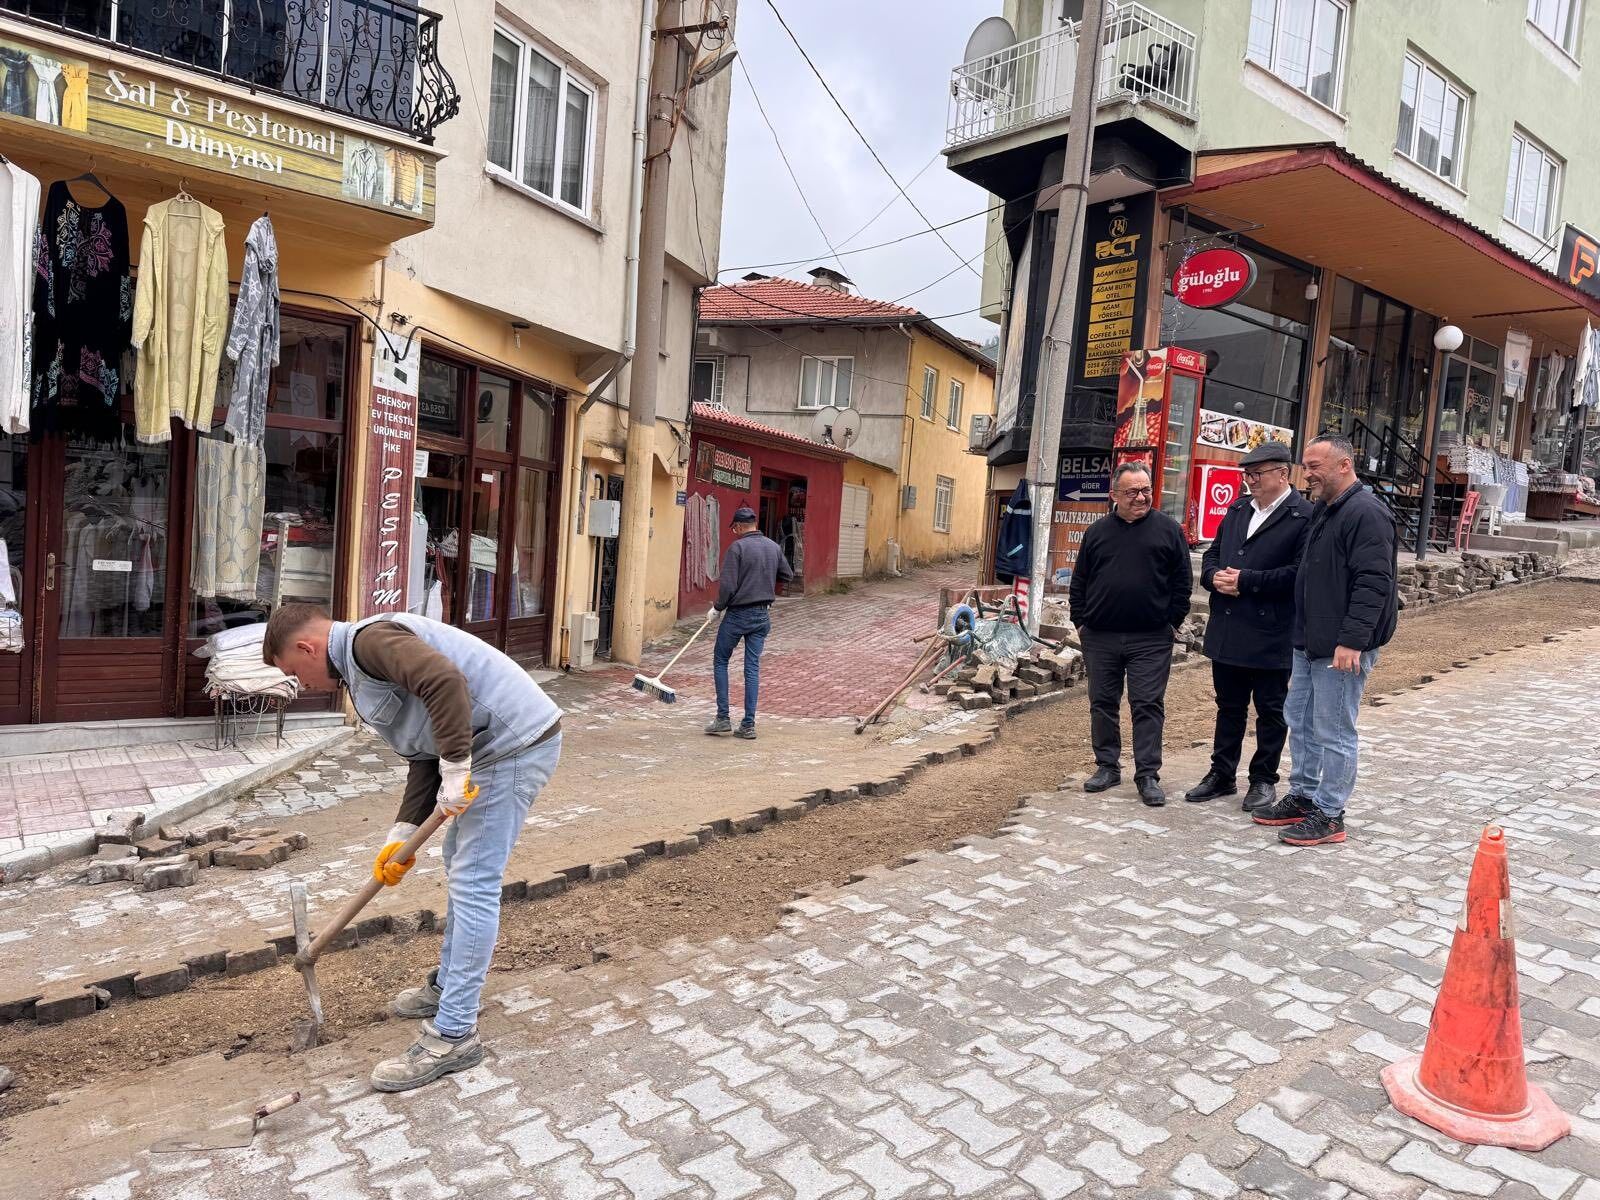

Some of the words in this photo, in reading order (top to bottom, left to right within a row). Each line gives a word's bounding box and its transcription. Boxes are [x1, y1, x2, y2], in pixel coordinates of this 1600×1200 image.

[105, 69, 156, 108] Şal
[171, 87, 191, 116] &
[207, 96, 336, 155] Peştemal
[165, 119, 283, 175] Dünyası
[1178, 267, 1240, 292] güloğlu
[376, 394, 411, 410] ERENSOY
[371, 409, 382, 419] EV
[384, 411, 415, 426] TEKSTİL
[382, 441, 401, 453] PİKE
[1081, 482, 1101, 490] GİDER
